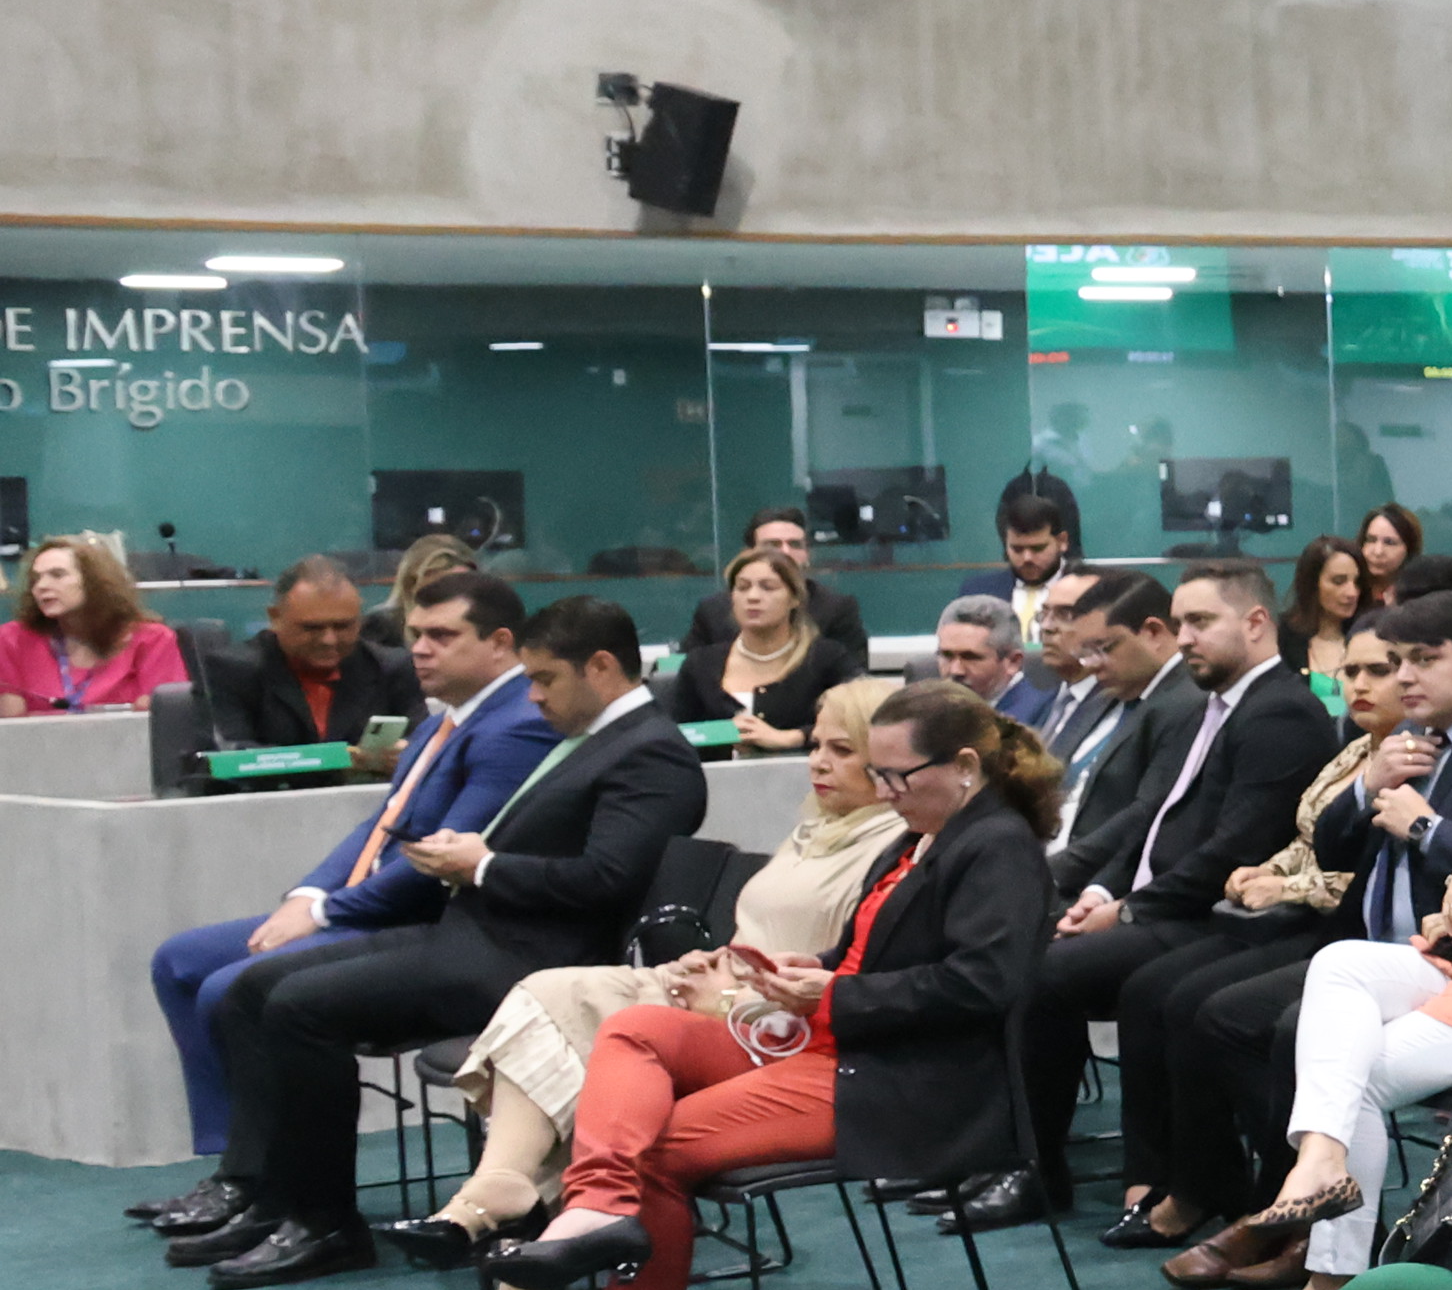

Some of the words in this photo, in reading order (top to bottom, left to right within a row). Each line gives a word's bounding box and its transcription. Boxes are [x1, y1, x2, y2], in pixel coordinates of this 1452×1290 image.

[0, 307, 36, 352] E
[65, 306, 370, 355] IMPRENSA
[48, 363, 251, 430] Brígido
